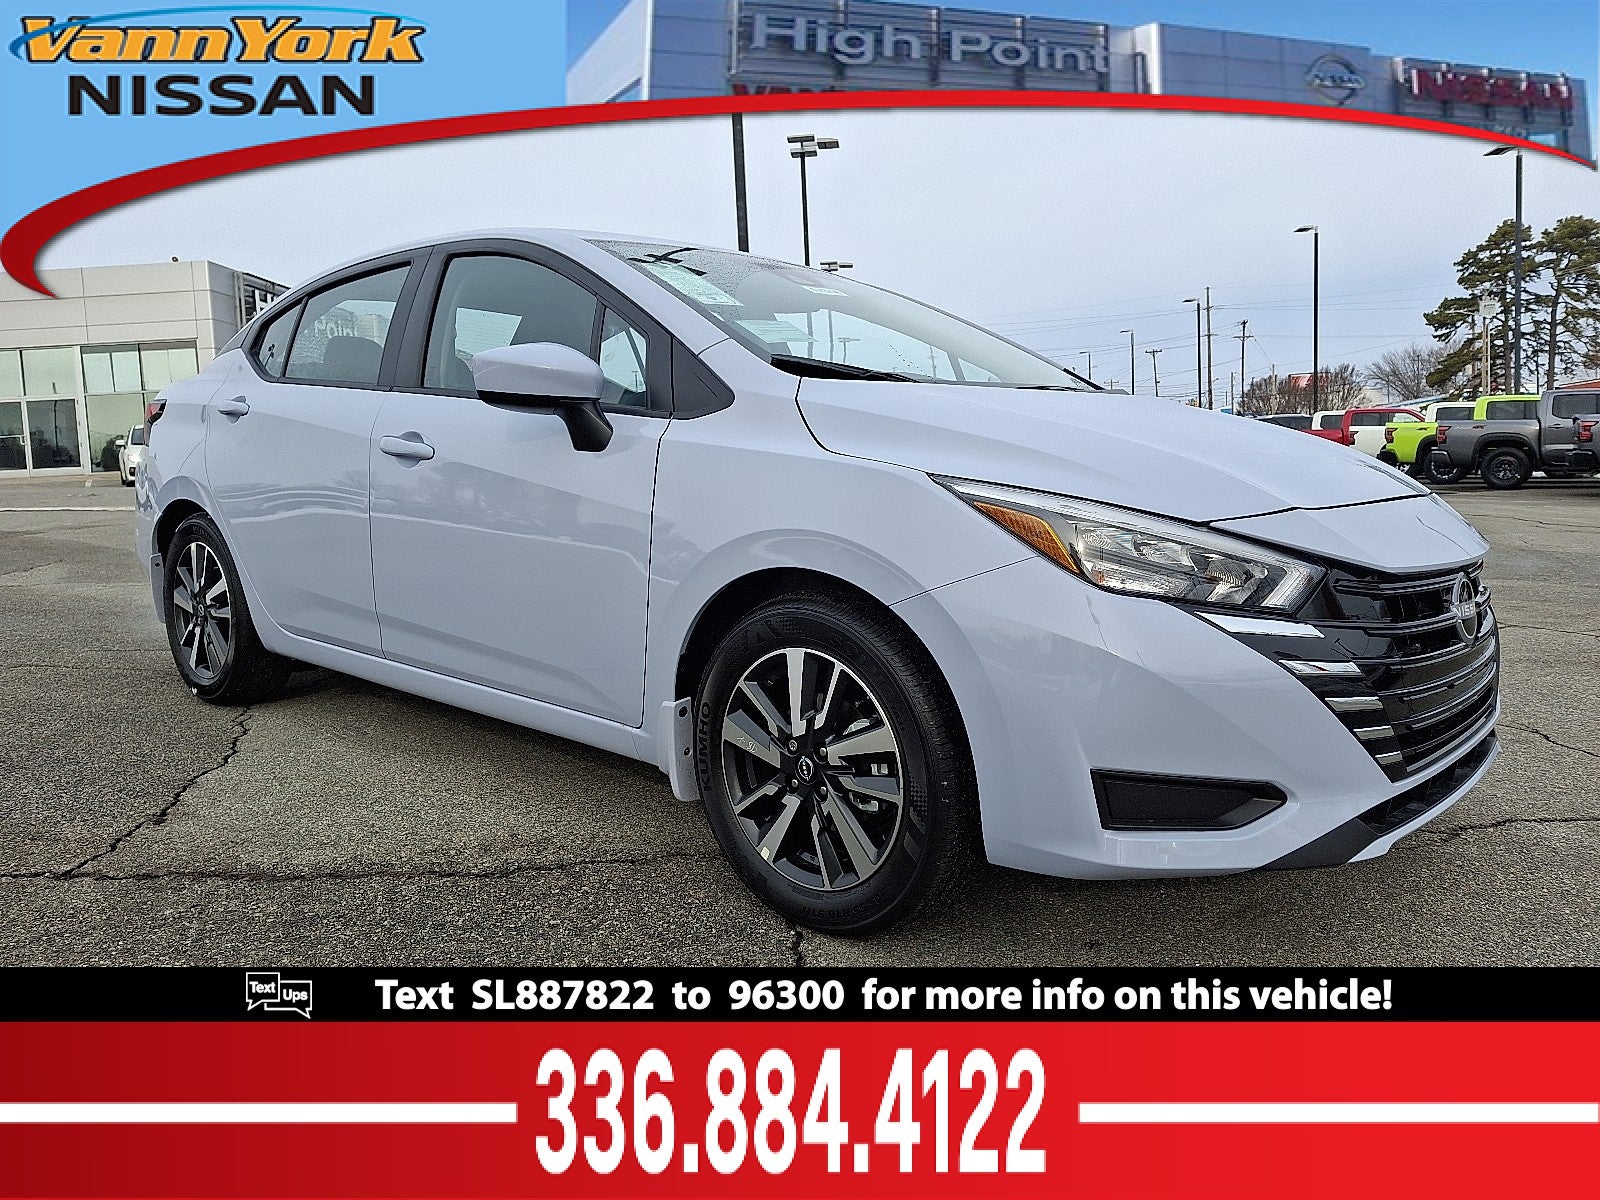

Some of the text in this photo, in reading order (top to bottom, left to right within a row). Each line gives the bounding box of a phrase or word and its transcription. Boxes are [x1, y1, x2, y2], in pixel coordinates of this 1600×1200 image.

[752, 14, 1109, 74] High Point
[1410, 68, 1573, 110] NISSAN
[698, 701, 711, 792] KUMHO
